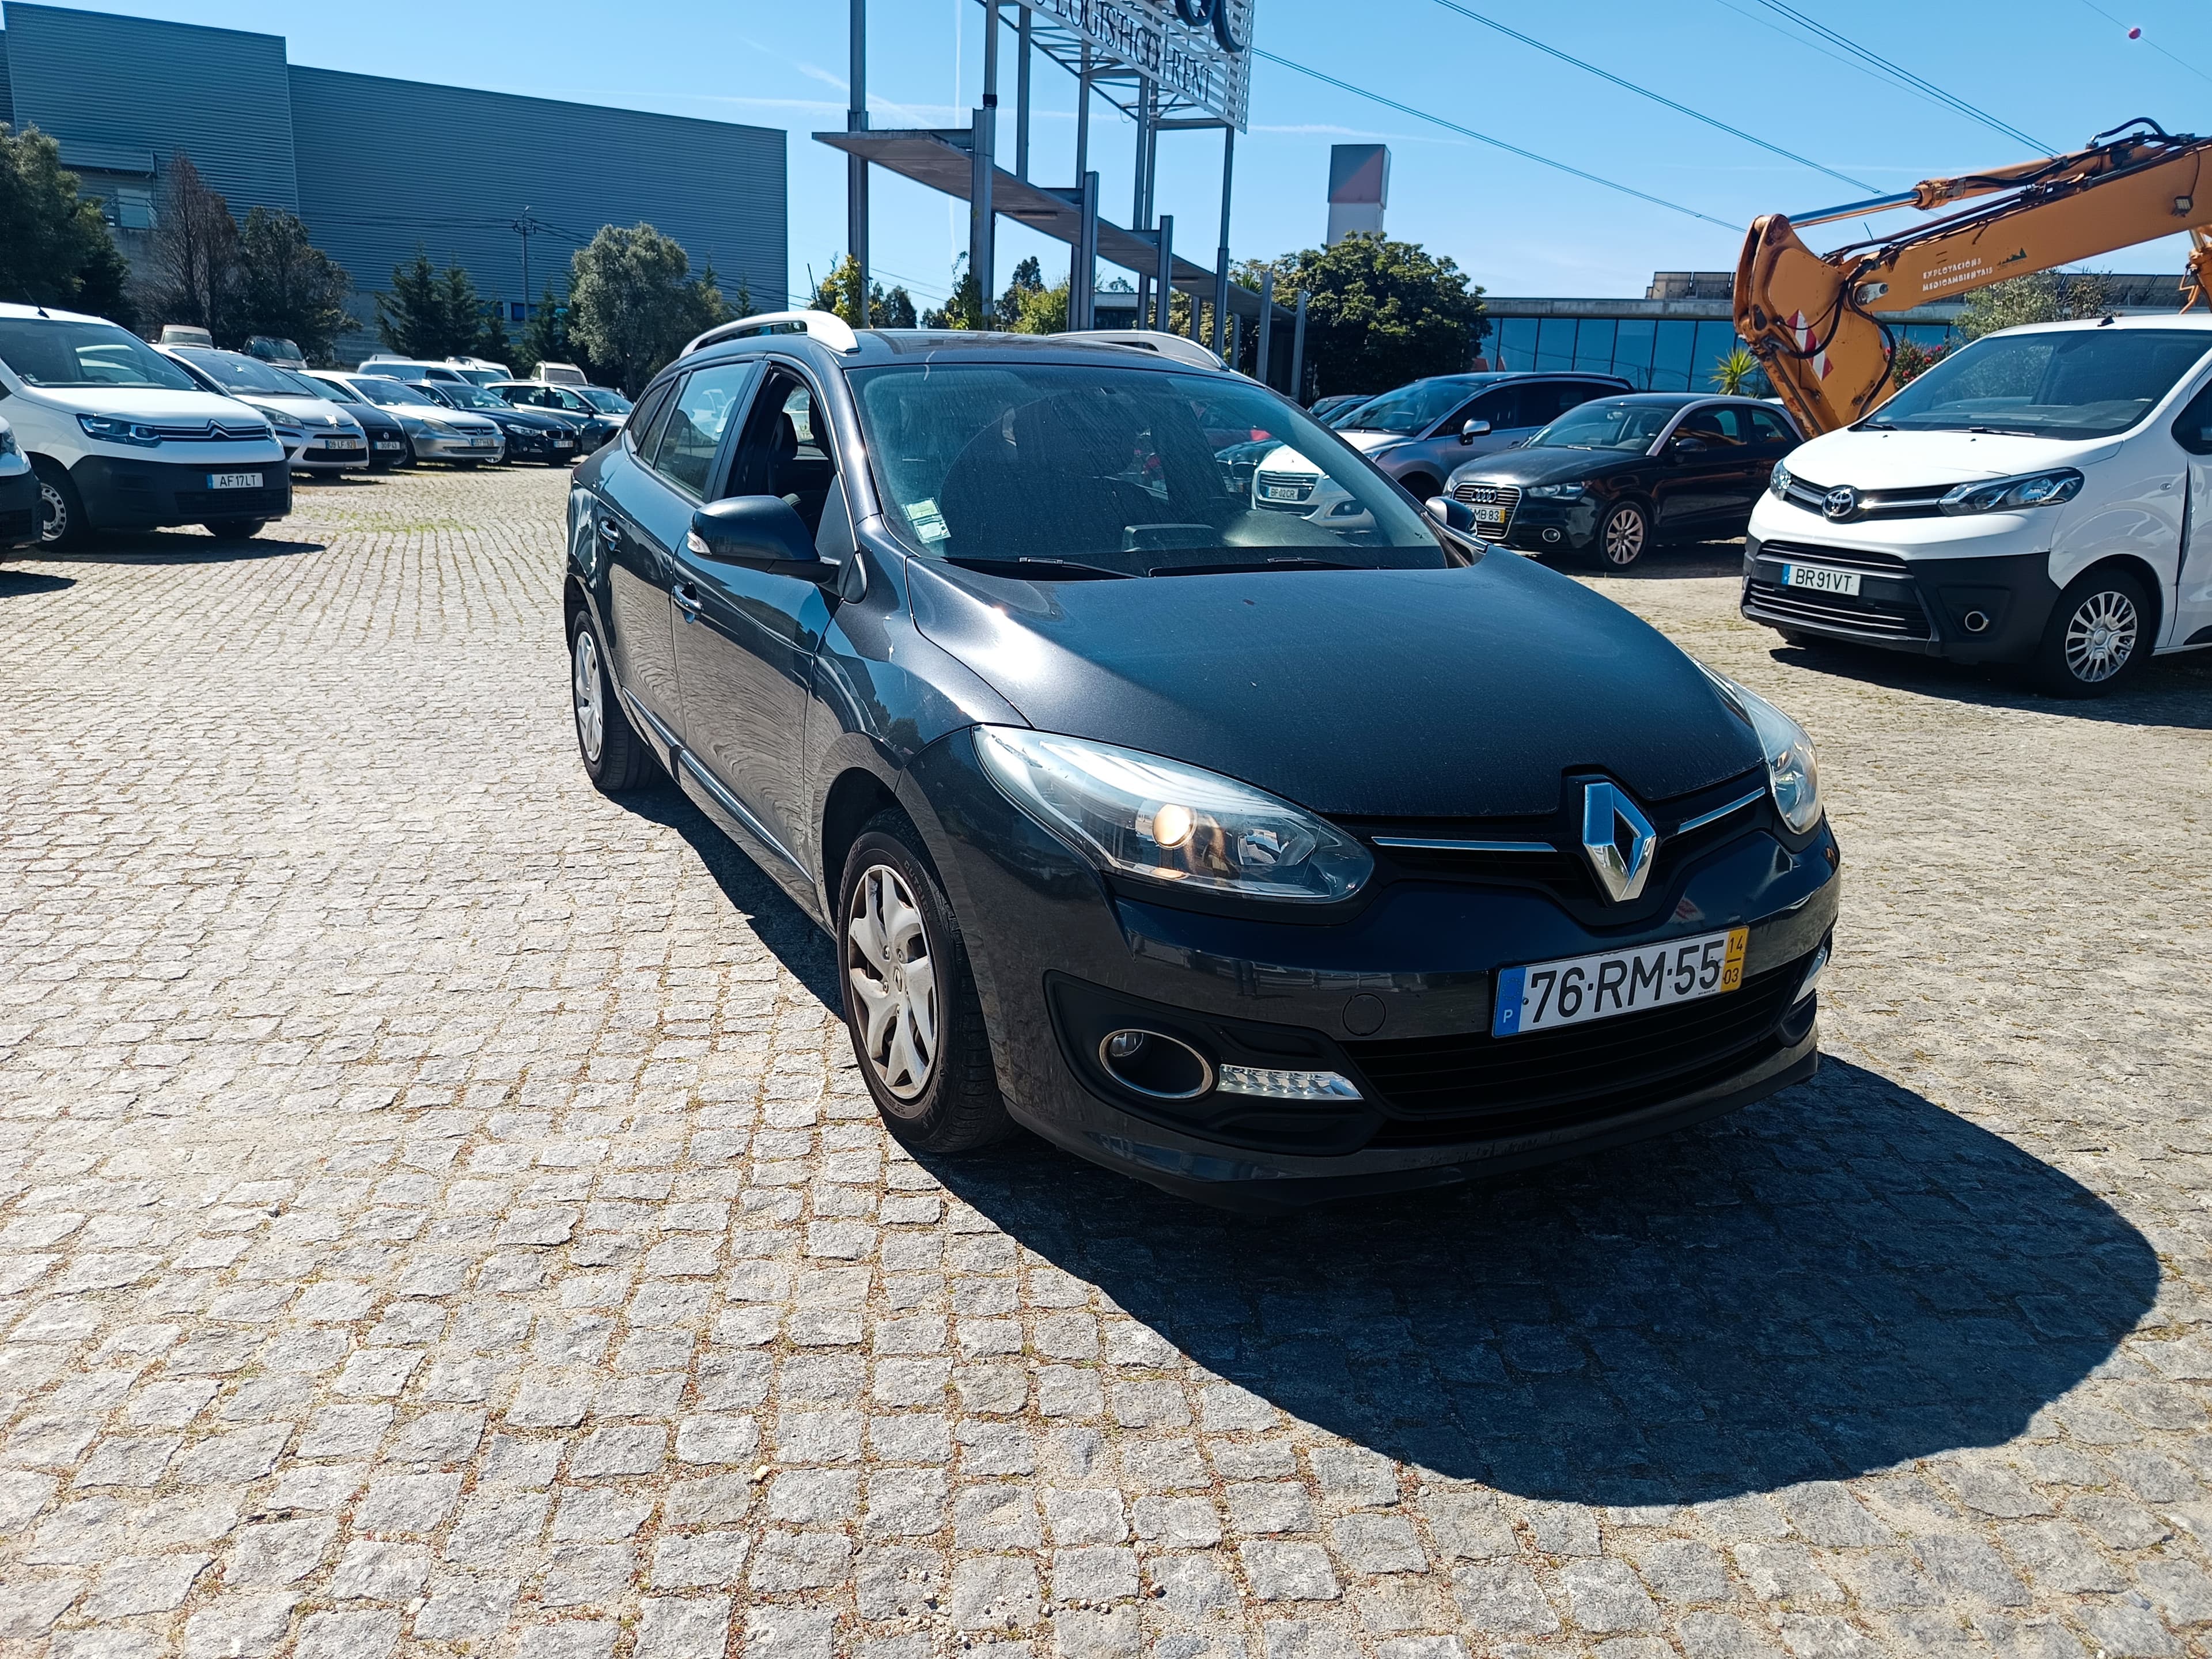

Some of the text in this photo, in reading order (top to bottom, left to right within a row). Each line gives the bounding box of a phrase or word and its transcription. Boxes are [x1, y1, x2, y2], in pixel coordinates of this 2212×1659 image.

[1171, 48, 1213, 103] RENT
[1730, 935, 1743, 953] 14
[1724, 967, 1739, 985] 03
[1502, 1009, 1513, 1024] P
